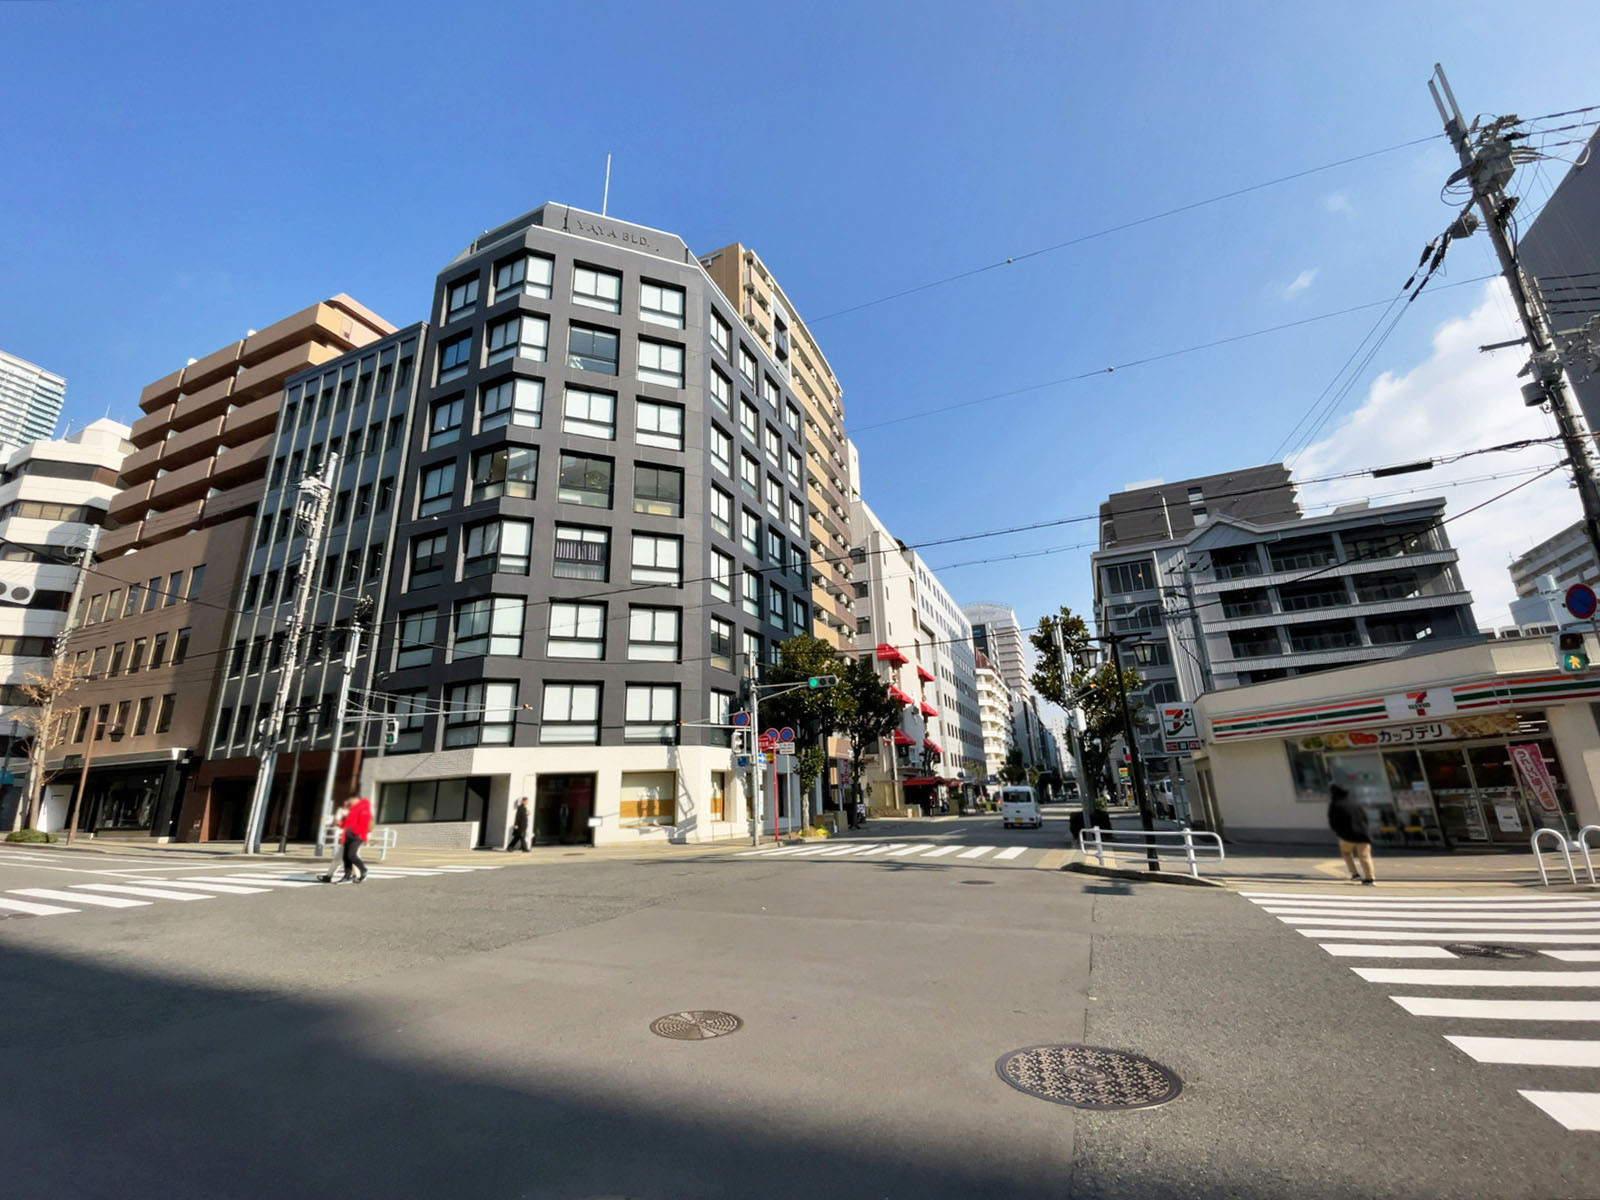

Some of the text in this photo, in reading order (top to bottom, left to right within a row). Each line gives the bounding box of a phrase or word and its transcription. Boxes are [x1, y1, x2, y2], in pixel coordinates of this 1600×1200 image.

[577, 220, 651, 247] YAYA BLD.
[1378, 723, 1443, 743] カップデリ
